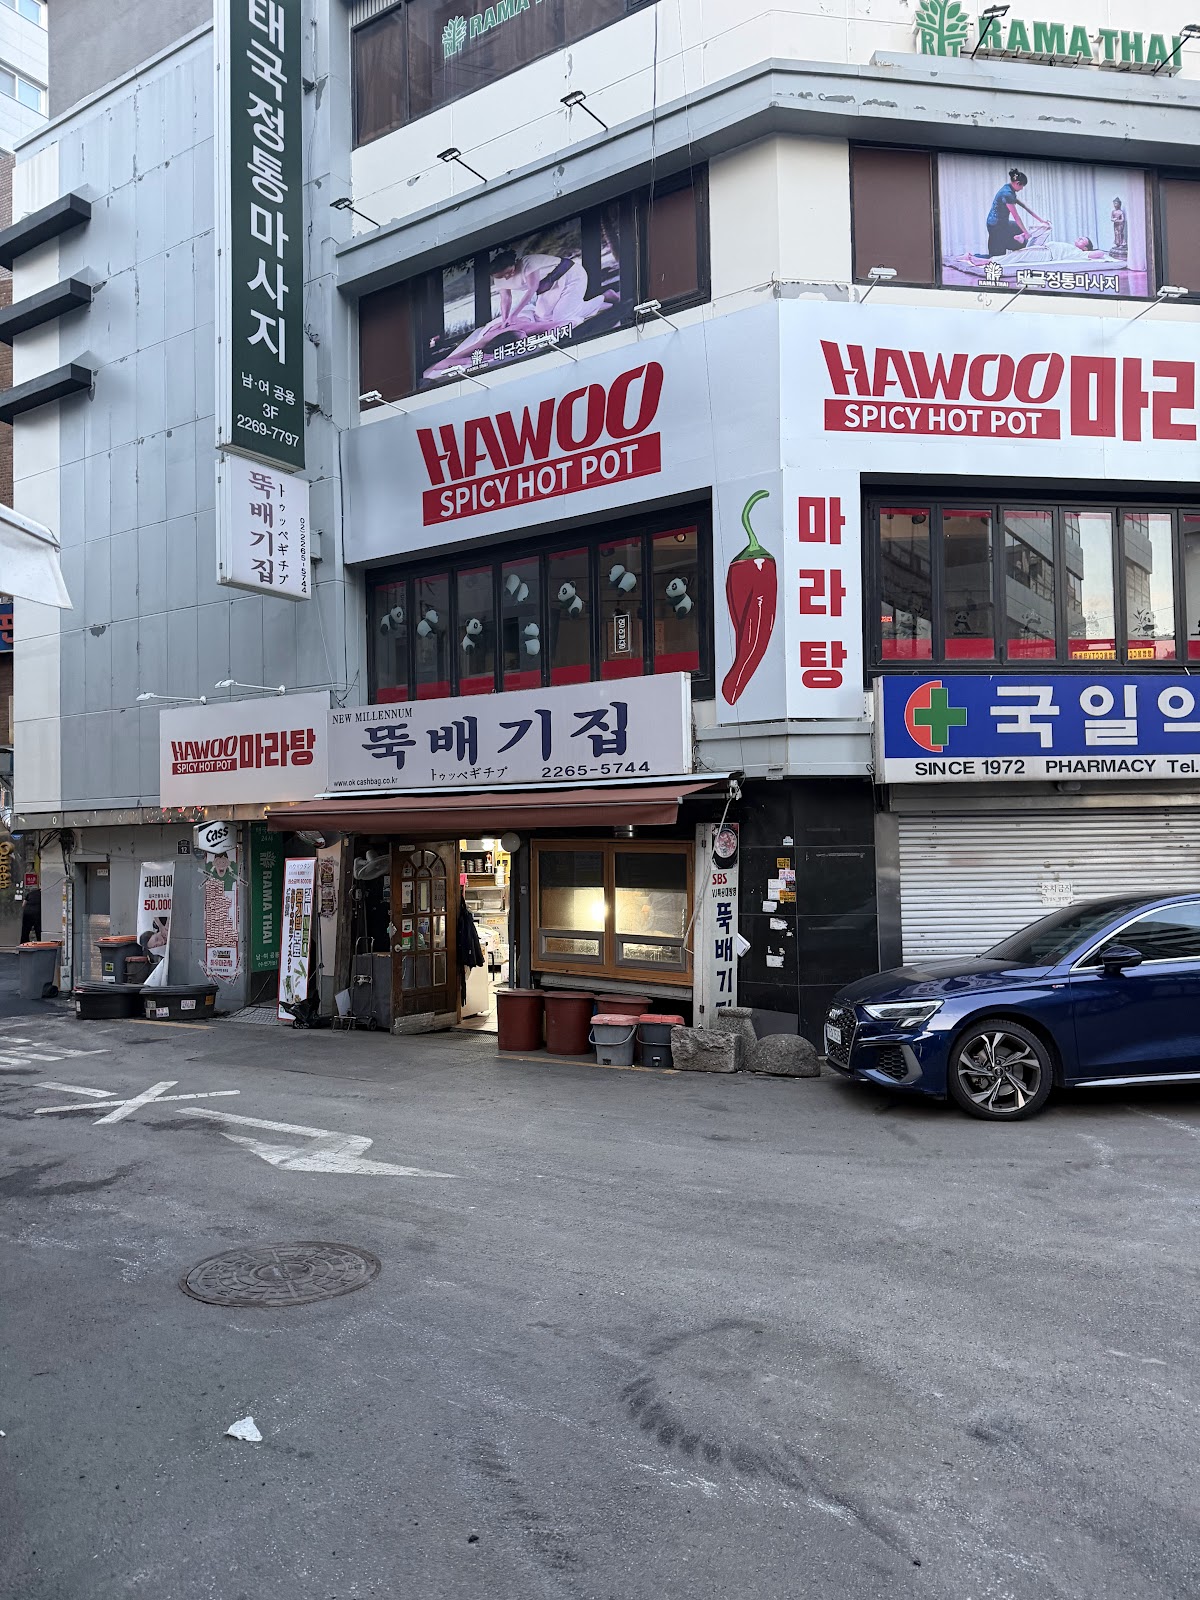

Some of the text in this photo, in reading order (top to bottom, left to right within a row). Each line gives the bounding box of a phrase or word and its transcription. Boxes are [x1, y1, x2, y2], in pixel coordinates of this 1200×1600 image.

[978, 16, 1183, 70] RAMA THAI
[246, 0, 288, 365] 태국정통마사지
[819, 339, 1065, 404] HAWOO
[262, 403, 279, 420] 3F
[272, 384, 296, 406] 공용
[236, 413, 300, 447] 2269-7797
[416, 361, 664, 487] HAWOO
[844, 403, 1042, 435] SPICY HOT POT
[439, 443, 639, 518] SPICY HOT POT
[248, 470, 276, 585] 뚝배기집
[798, 496, 848, 689] 마라탕
[332, 707, 413, 725] NEW MILLENNUM
[171, 735, 239, 761] HAWOO
[239, 728, 316, 769] 마라탕
[361, 701, 629, 771] 뚝배기집
[176, 759, 232, 774] SPICY HOT POT
[541, 760, 651, 779] 2265-5744
[914, 758, 1200, 776] SINCE 1972 PHARMACY Tel.
[712, 873, 728, 885] SBS
[143, 898, 172, 911] 50.000
[262, 870, 273, 945] RAMA THAI
